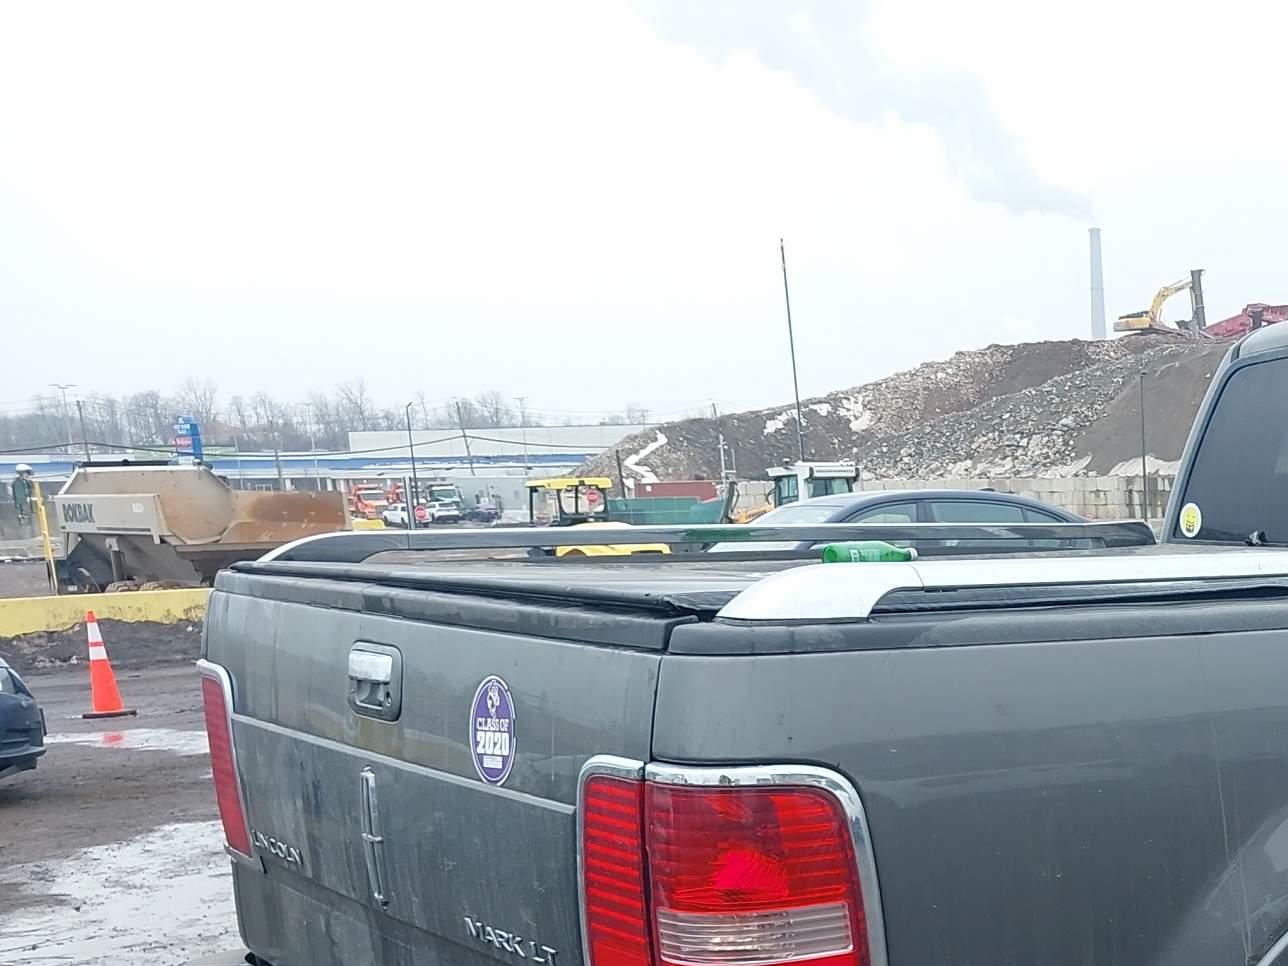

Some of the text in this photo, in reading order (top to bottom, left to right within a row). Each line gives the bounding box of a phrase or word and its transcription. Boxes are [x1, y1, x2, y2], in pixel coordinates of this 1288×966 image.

[476, 718, 509, 731] CLASS OF
[476, 731, 510, 756] 2020
[250, 829, 303, 865] LINCOLN
[463, 916, 558, 966] MARK LT
